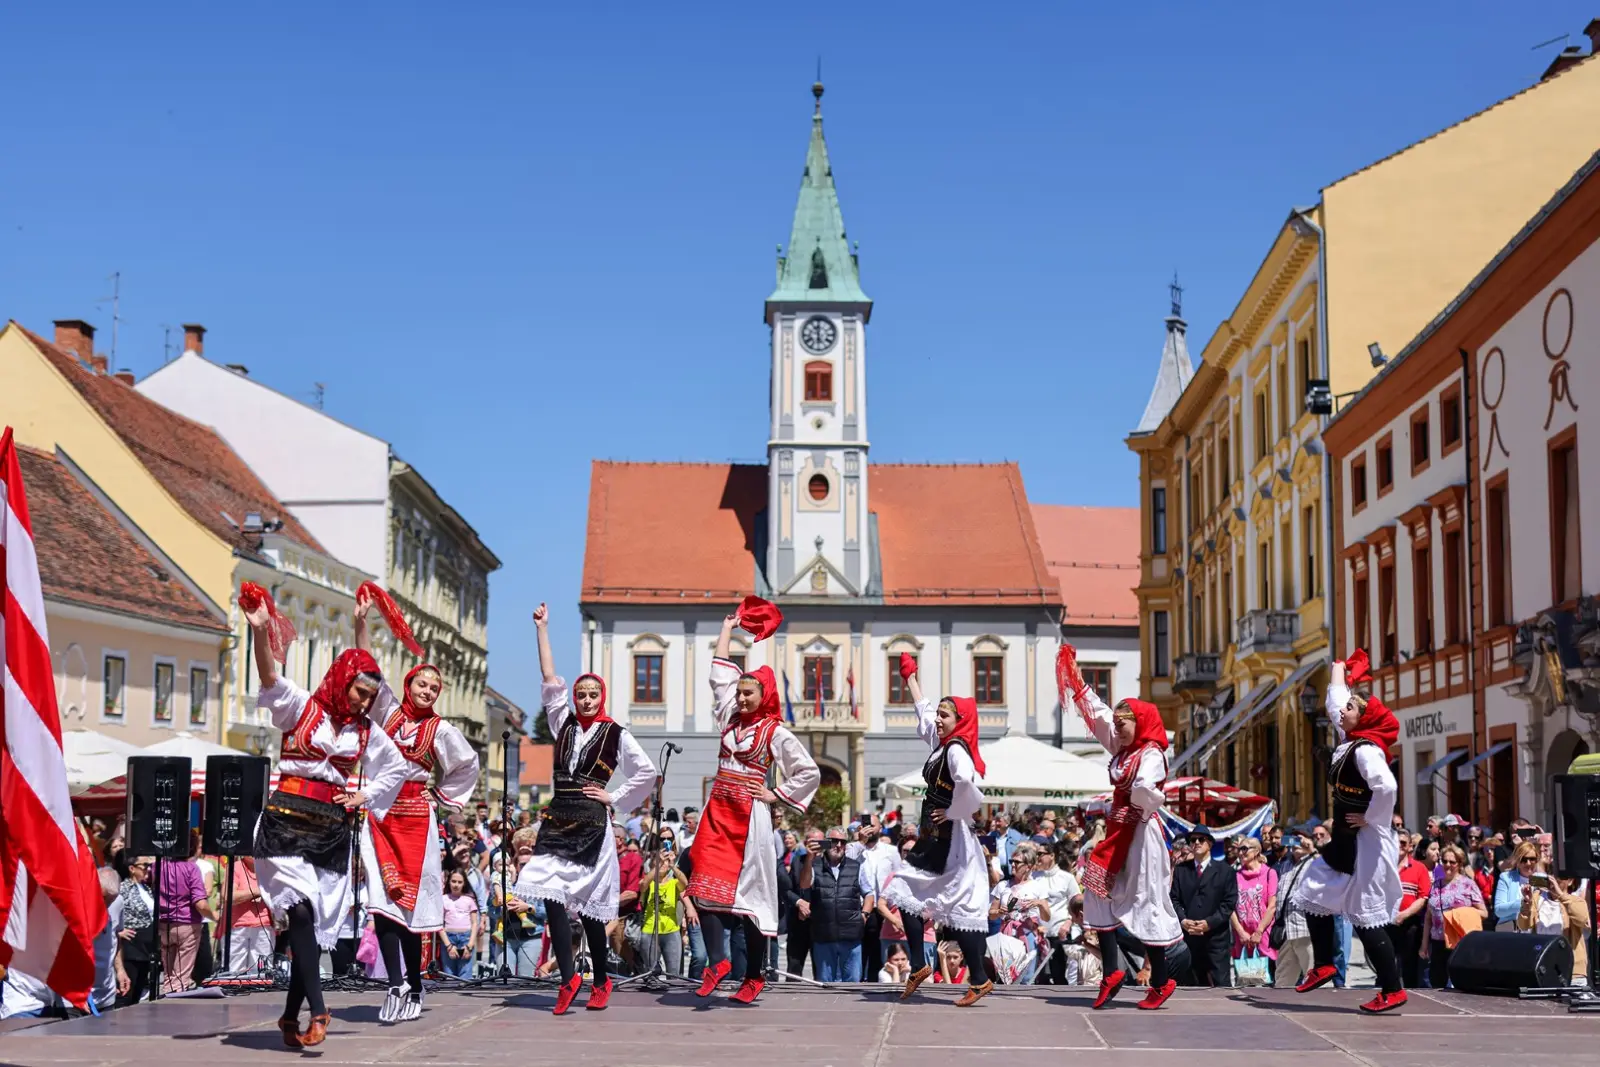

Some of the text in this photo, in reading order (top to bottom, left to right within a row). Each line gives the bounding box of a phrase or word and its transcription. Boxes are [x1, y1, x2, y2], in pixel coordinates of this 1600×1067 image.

[1404, 711, 1443, 738] VARTEKS
[978, 786, 1004, 797] AN
[1043, 790, 1073, 799] PAN
